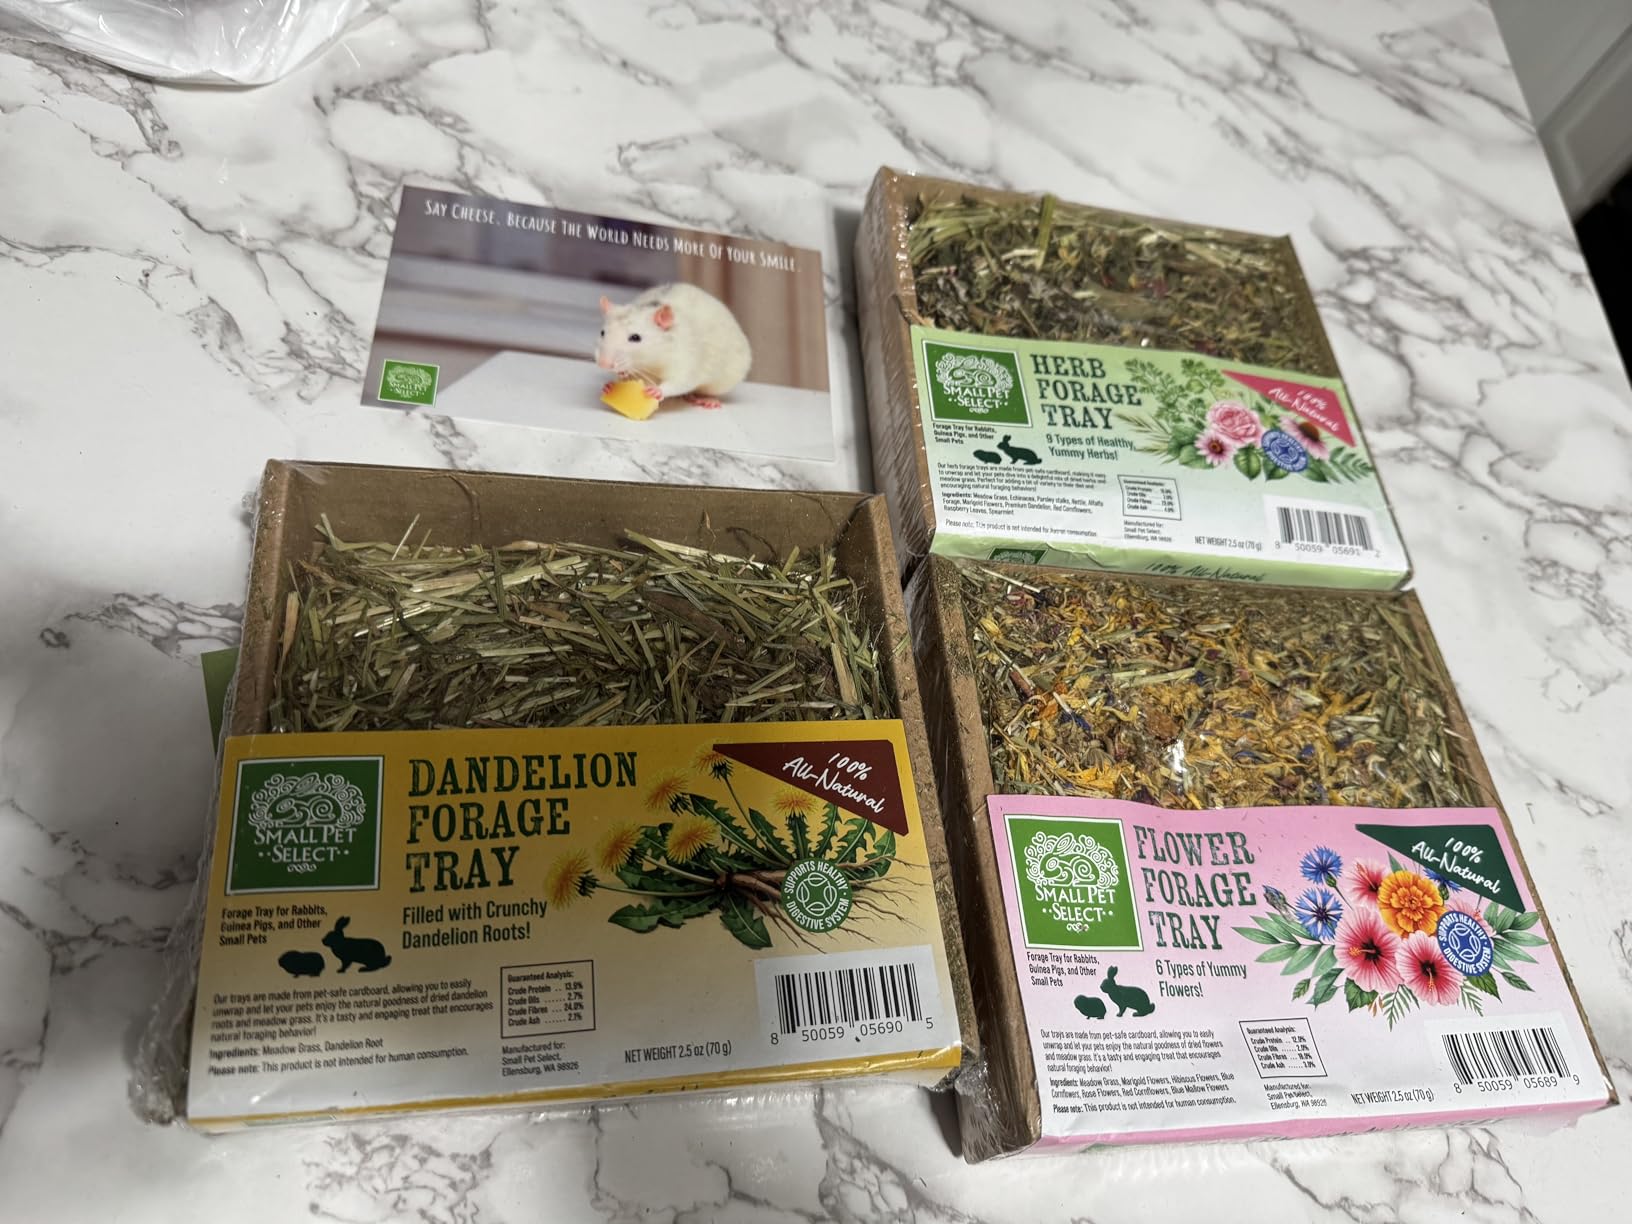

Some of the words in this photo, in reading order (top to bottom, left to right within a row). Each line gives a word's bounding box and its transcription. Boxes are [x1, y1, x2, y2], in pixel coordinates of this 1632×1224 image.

[1030, 354, 1106, 378] HERB
[1036, 378, 1142, 406] FORAGE
[1041, 403, 1113, 430] TRAY
[1046, 433, 1053, 444] 9
[1055, 434, 1083, 447] Types
[1085, 435, 1095, 445] of
[1097, 436, 1136, 451] Healthy,
[1048, 446, 1085, 460] Yummy
[1087, 448, 1118, 460] Herbs!
[408, 751, 638, 797] DANDELION
[828, 753, 873, 781] 100%
[782, 756, 885, 814] All-Natural
[406, 798, 570, 844] FORAGE
[1133, 825, 1255, 866] FLOWER
[1445, 837, 1484, 864] 100%
[406, 846, 520, 893] TRAY
[784, 860, 816, 894] SUPPORTS
[817, 861, 848, 891] HEALTHY
[1412, 840, 1501, 894] All-Natural
[1141, 867, 1257, 907] FORAGE
[222, 908, 253, 920] Forage
[255, 906, 274, 918] Tray
[276, 905, 289, 916] for
[292, 904, 328, 917] Rabbits,
[403, 905, 444, 925] Filled
[448, 903, 482, 921] with
[486, 897, 548, 919] Crunchy
[786, 901, 824, 930] DIGESTIVE
[826, 897, 849, 929] SYSTEM
[220, 921, 252, 933] Guinea
[254, 920, 276, 931] Pigs,
[278, 919, 294, 929] and
[296, 918, 321, 929] Other
[402, 925, 478, 949] Dandelion
[483, 922, 531, 942] Roots!
[1148, 910, 1223, 950] TRAY
[1438, 912, 1459, 943] SUPPORTS
[1458, 913, 1487, 941] HEALTHY
[219, 934, 245, 946] Small
[247, 933, 267, 945] Pets
[1027, 952, 1048, 963] Forage
[1049, 953, 1062, 964] Tray
[1064, 953, 1072, 962] for
[1073, 954, 1100, 965] Rabbits,
[1028, 963, 1051, 974] Guinea
[1051, 964, 1067, 976] Pigs,
[1067, 966, 1079, 975] and
[1079, 966, 1097, 976] Other
[1155, 959, 1163, 976] 6
[1164, 960, 1194, 979] Types
[1196, 961, 1206, 977] of
[1206, 961, 1247, 979] Yummy
[1443, 948, 1477, 974] DIGESTIVE
[1477, 946, 1492, 973] SYSTEM
[214, 993, 227, 1004] Our
[230, 993, 250, 1004] trays
[253, 993, 266, 1001] are
[268, 991, 290, 1000] made
[293, 989, 312, 999] from
[314, 987, 347, 999] pet-safe
[392, 983, 423, 994] allowing
[425, 982, 439, 992] you
[440, 981, 449, 990] to
[450, 979, 471, 990] easily
[1031, 976, 1049, 985] Small
[1050, 977, 1063, 987] Pets
[1158, 980, 1204, 997] Flowers!
[770, 1032, 779, 1045] 8
[801, 1025, 845, 1042] 50059
[860, 1021, 903, 1036] 05690
[926, 1017, 934, 1030] 5
[262, 1044, 296, 1055] Meadow
[298, 1042, 322, 1053] Grass,
[325, 1040, 363, 1051] Dandelion
[365, 1038, 383, 1048] Root
[502, 1042, 551, 1054] Manufactured
[553, 1041, 565, 1050] for:
[625, 1049, 641, 1063] NET
[643, 1046, 677, 1061] WEIGHT
[679, 1045, 692, 1058] 2.5
[694, 1046, 704, 1057] oz
[705, 1042, 720, 1058] (70
[721, 1041, 732, 1056] g)
[502, 1055, 522, 1065] Small
[524, 1054, 536, 1063] Pet
[544, 1064, 555, 1072] WA
[1351, 1092, 1366, 1105] NET
[1367, 1090, 1393, 1104] WEIGHT
[1392, 1090, 1404, 1102] 2.5
[1404, 1091, 1413, 1102] oz
[1413, 1088, 1425, 1102] (70
[1426, 1087, 1434, 1102] g)
[1453, 1082, 1462, 1094] 8
[1477, 1079, 1513, 1093] 50059
[1523, 1076, 1558, 1089] 05689
[1573, 1074, 1580, 1086] 9
[1053, 1104, 1069, 1113] Please
[1084, 1103, 1097, 1112] This
[1099, 1102, 1120, 1112] product
[1121, 1102, 1127, 1110] is
[1128, 1102, 1137, 1110] not
[1138, 1101, 1164, 1110] intended
[1165, 1100, 1174, 1108] for
[1175, 1099, 1196, 1107] human
